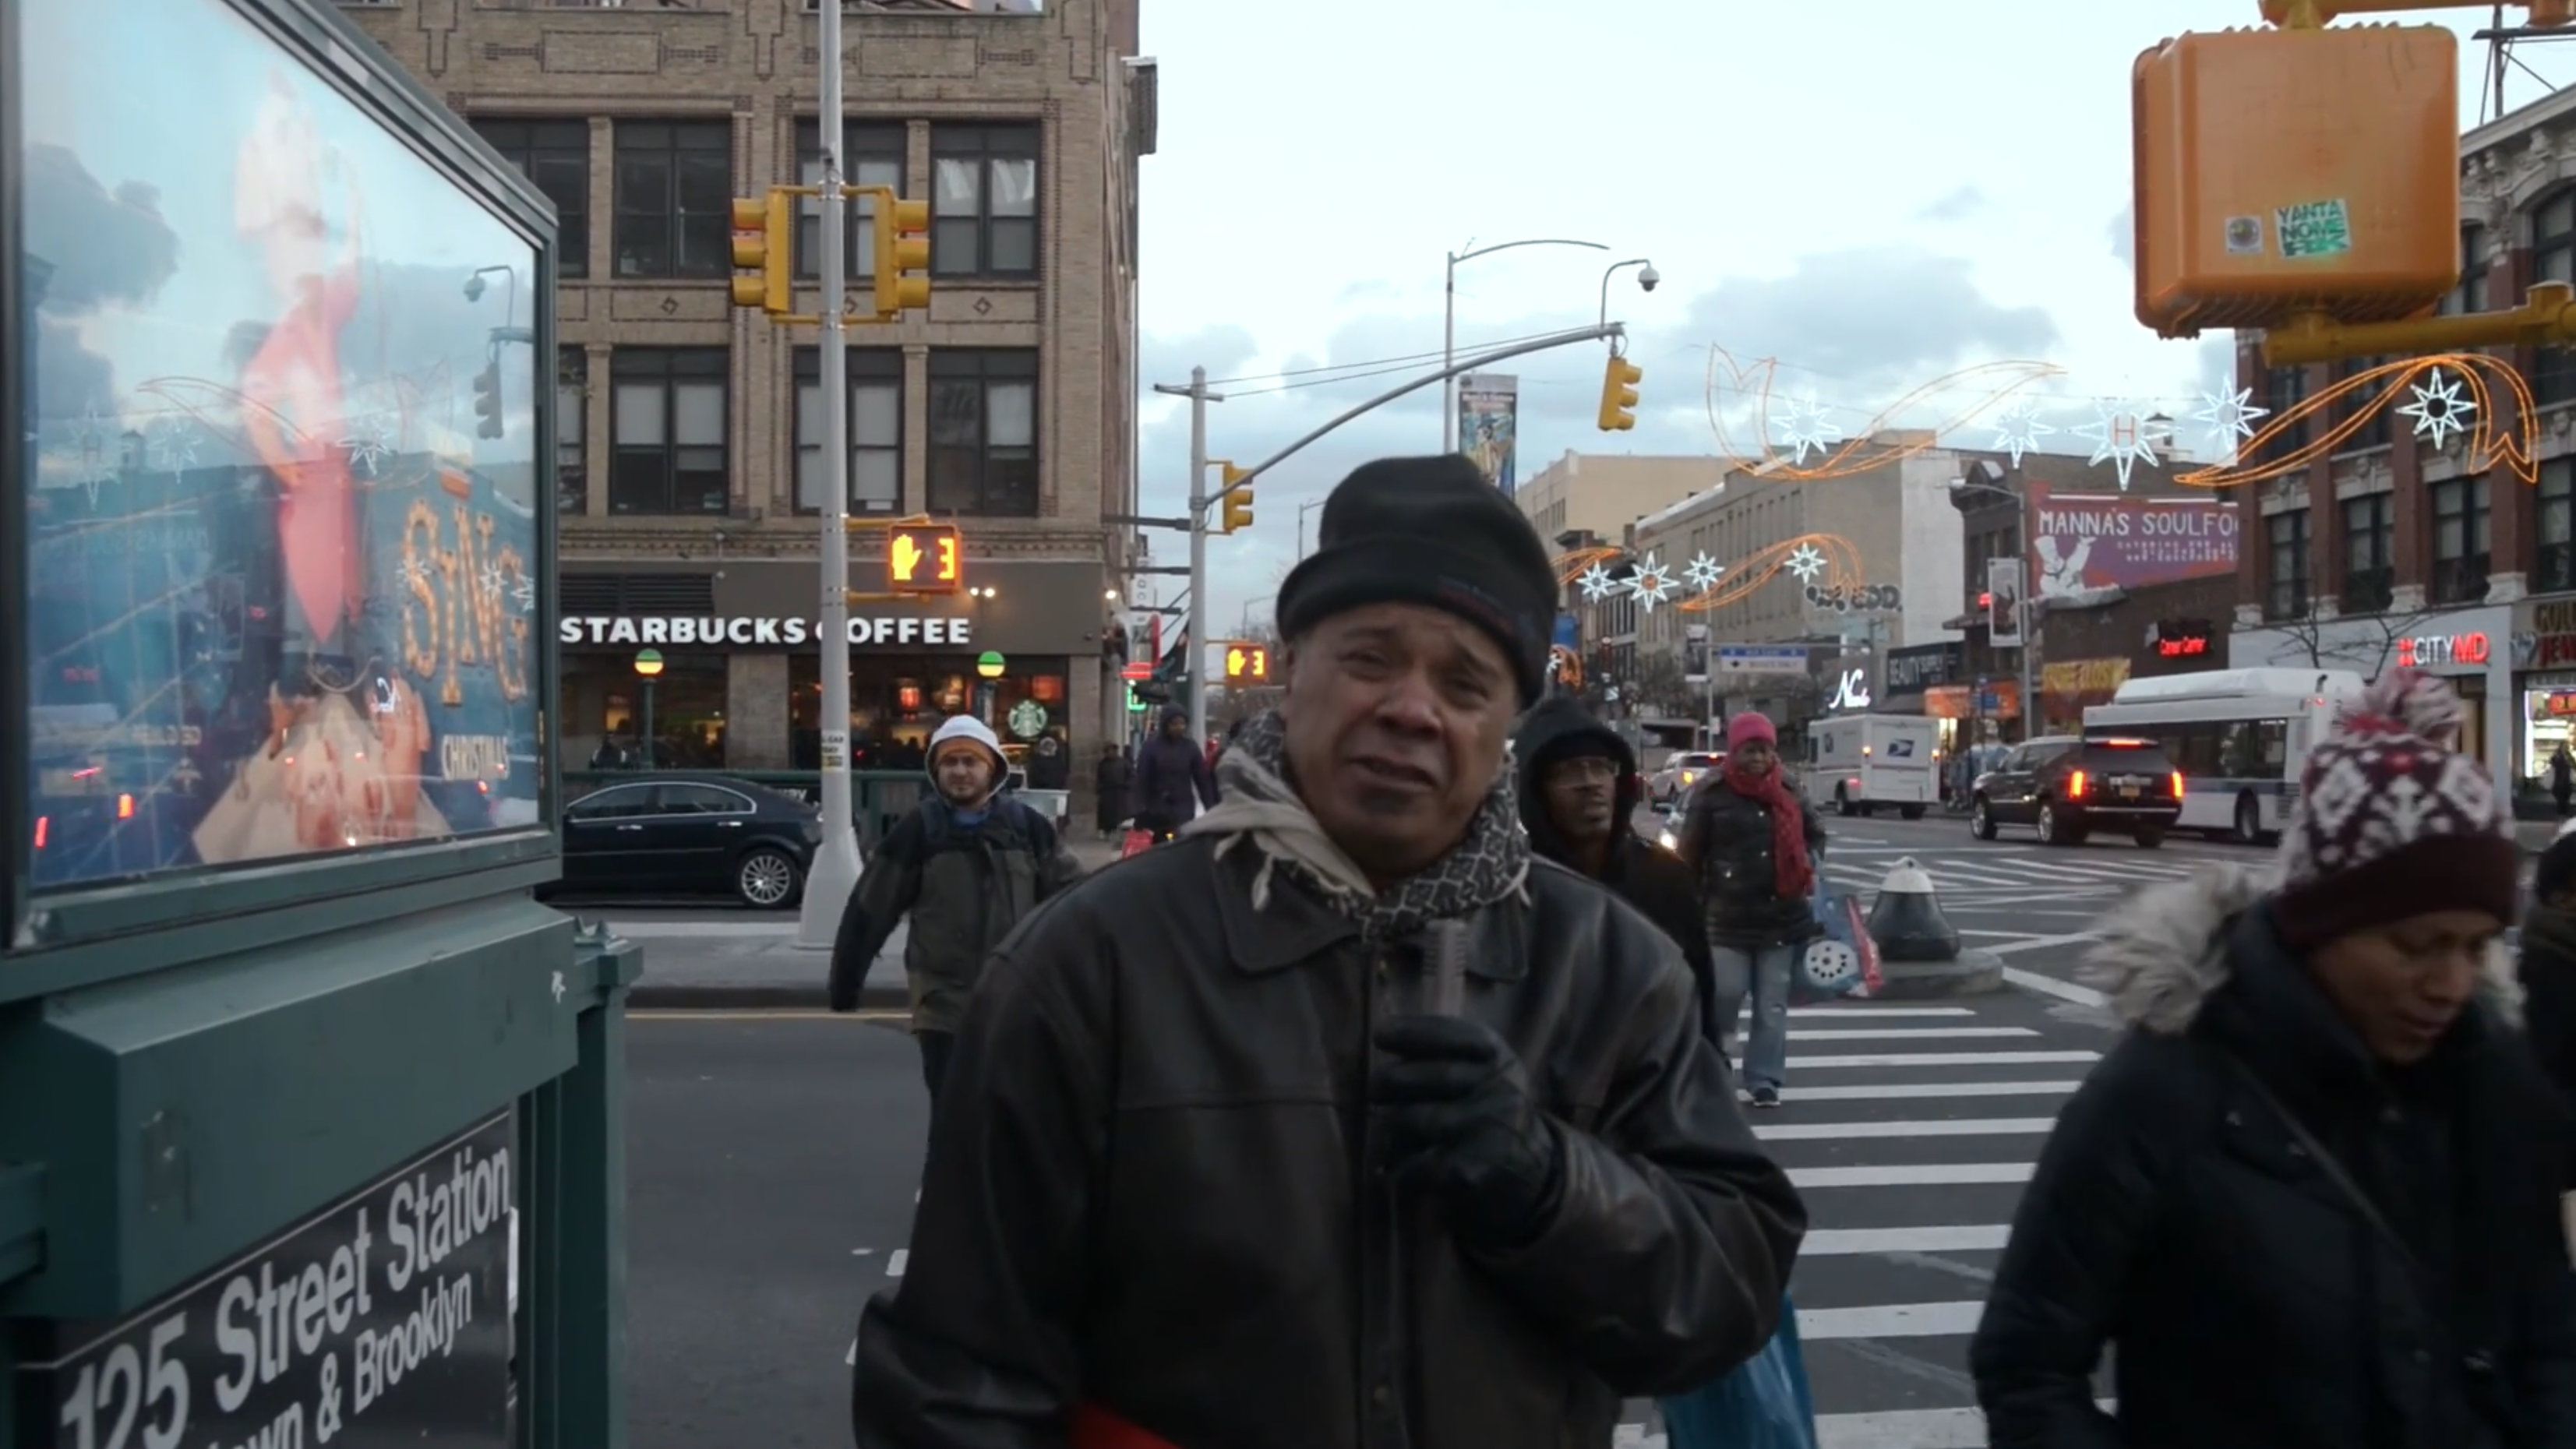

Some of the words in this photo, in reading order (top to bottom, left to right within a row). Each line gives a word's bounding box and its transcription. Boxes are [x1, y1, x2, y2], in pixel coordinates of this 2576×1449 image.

[2142, 513, 2239, 536] SOULFO
[938, 538, 955, 580] 3
[560, 617, 806, 643] STARBUCKS
[816, 618, 969, 643] OFFEE
[1253, 650, 1263, 675] 3
[2414, 633, 2490, 664] CITYMD
[61, 1310, 190, 1449] 125
[214, 1207, 372, 1412] Street
[388, 1145, 510, 1291] Station
[316, 1352, 342, 1444] &
[354, 1271, 472, 1415] Brooklyn
